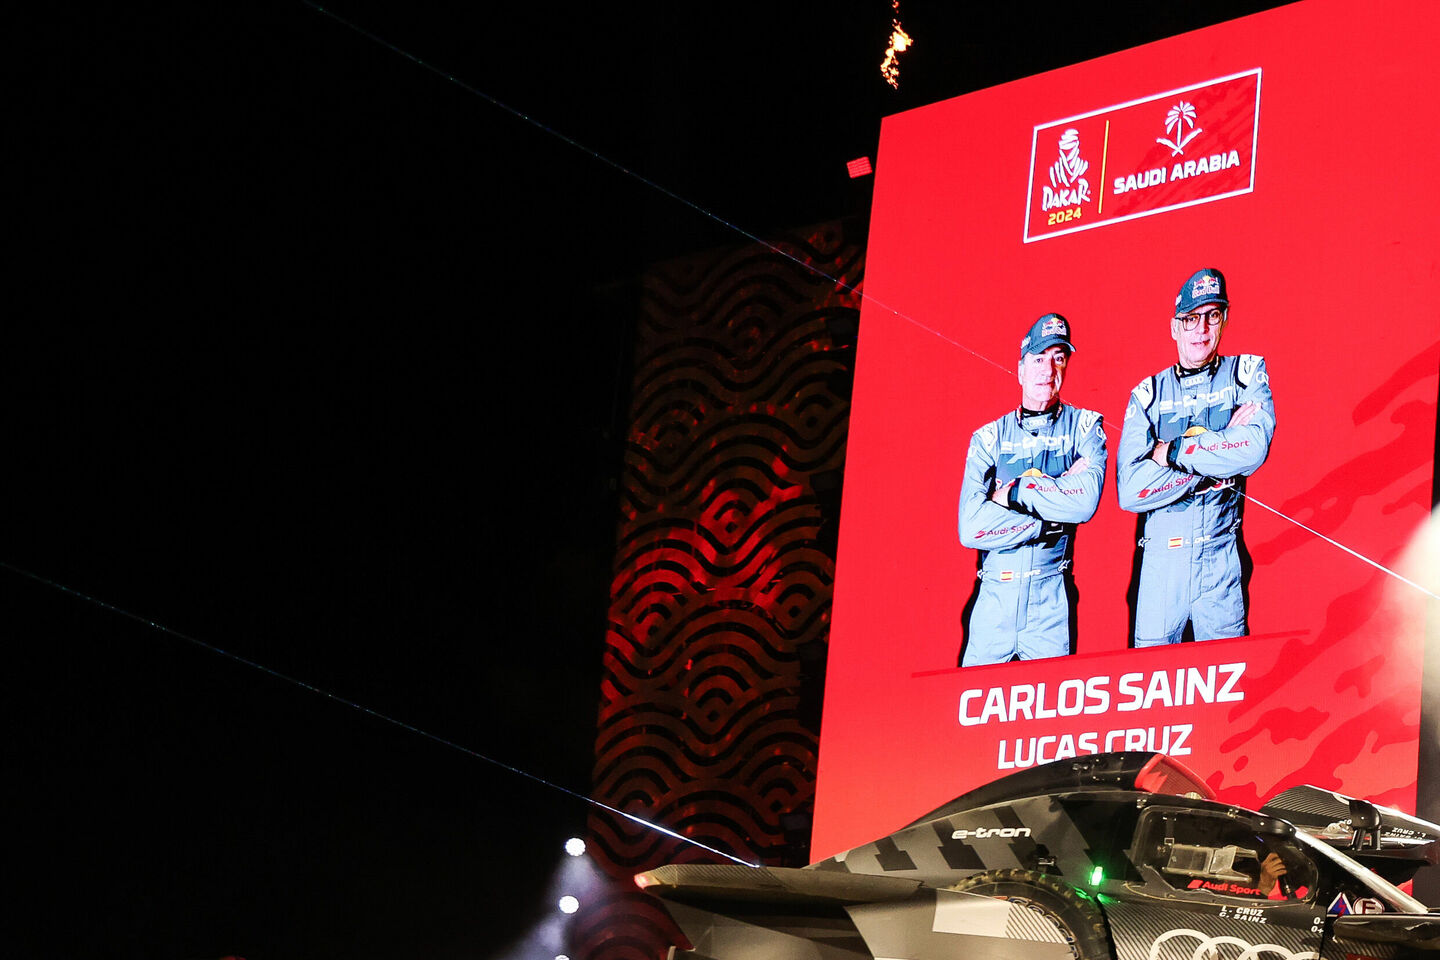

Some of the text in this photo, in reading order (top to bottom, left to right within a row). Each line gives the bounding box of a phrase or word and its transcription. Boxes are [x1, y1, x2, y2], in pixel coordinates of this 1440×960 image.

[1113, 150, 1240, 195] SAUDI ARABIA
[1042, 178, 1091, 211] DAKAR
[1047, 207, 1082, 226] 2024
[1221, 440, 1249, 450] Sport
[1175, 474, 1194, 486] Spo
[958, 662, 1247, 727] CARLOS SAINZ
[998, 724, 1194, 770] LUCAS CRUZ
[951, 826, 1032, 840] e-tron
[1202, 880, 1262, 897] Audi Sport
[1236, 906, 1264, 917] CRUZ
[1362, 900, 1376, 914] F
[1233, 914, 1268, 924] SAINZ
